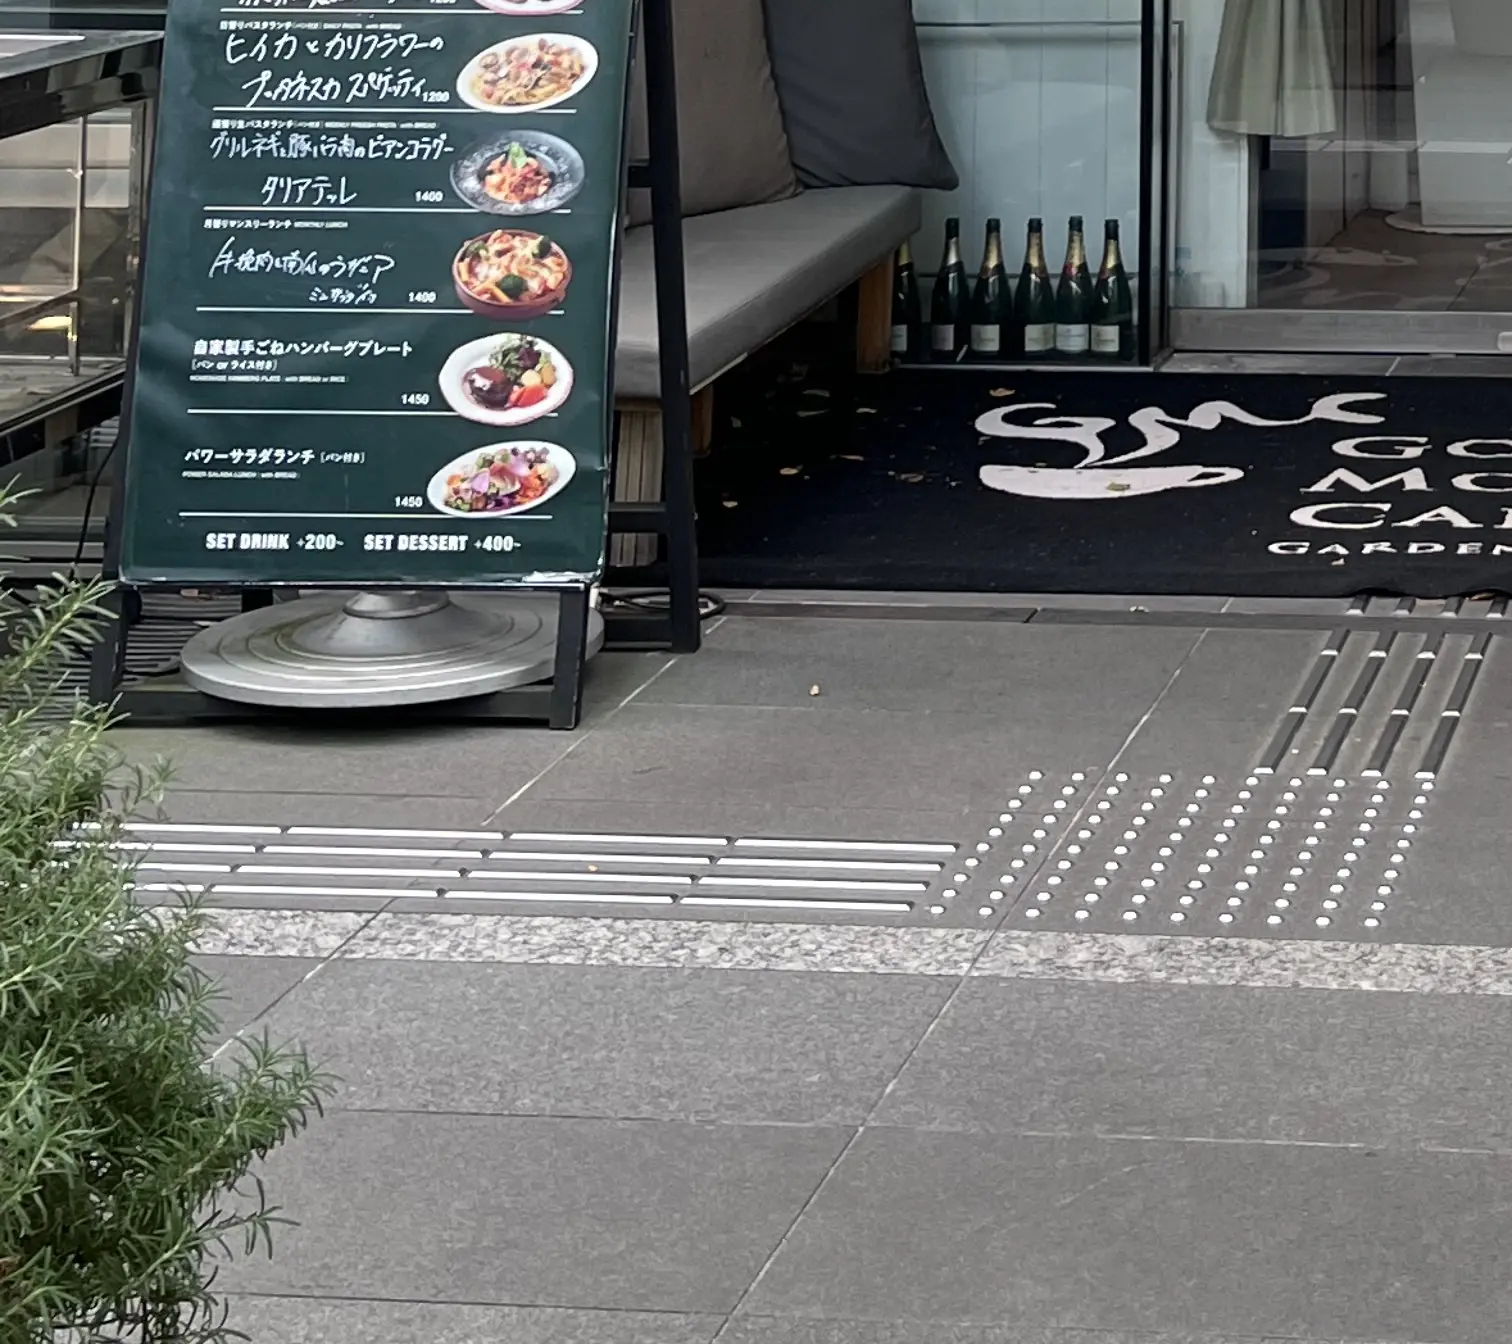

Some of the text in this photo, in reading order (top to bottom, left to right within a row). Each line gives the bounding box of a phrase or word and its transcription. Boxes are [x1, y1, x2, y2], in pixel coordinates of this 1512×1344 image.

[422, 91, 450, 103] 1200
[261, 176, 358, 206] タリアテッレ
[415, 190, 444, 203] 1400
[408, 290, 437, 303] 1400
[400, 393, 430, 405] 1450
[184, 448, 315, 465] パワーサラダランチ
[394, 495, 423, 507] 1450
[205, 532, 236, 550] SET
[238, 532, 290, 550] DRINK
[363, 534, 395, 551] SET
[397, 534, 469, 551] DESSERT
